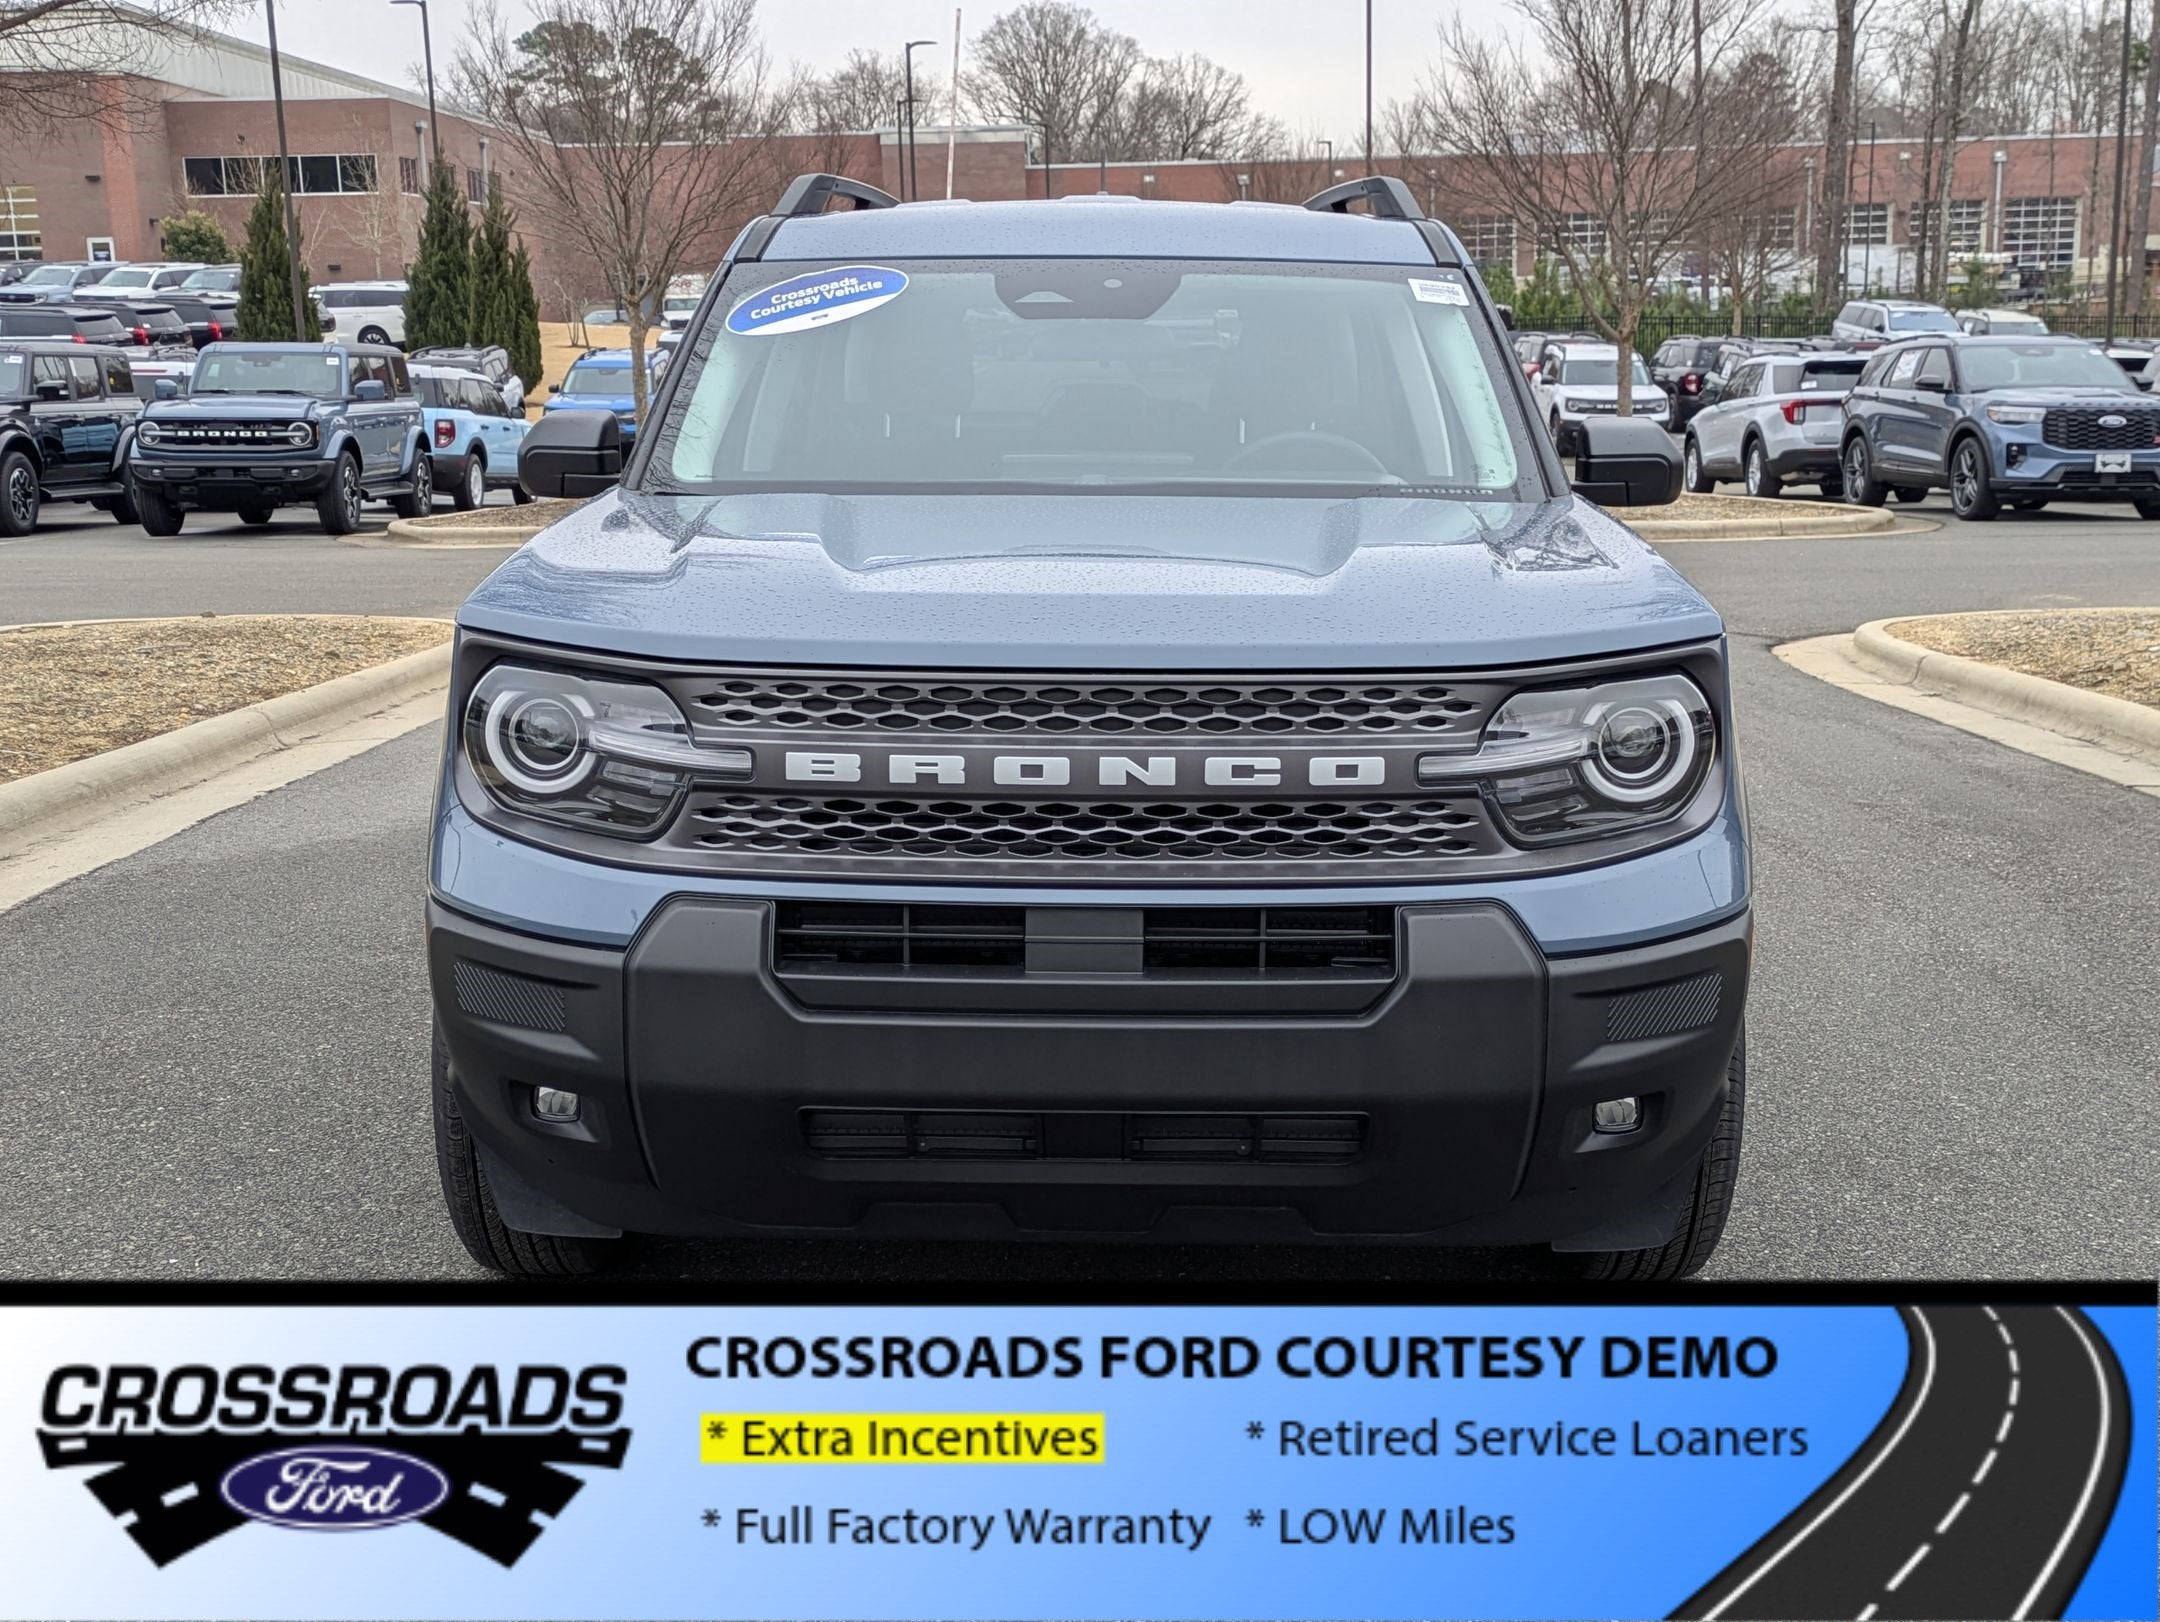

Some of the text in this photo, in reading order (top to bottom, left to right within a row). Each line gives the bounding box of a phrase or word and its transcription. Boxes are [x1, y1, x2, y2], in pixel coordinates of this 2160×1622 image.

[750, 280, 884, 320] Courtesy Vehicle
[770, 277, 859, 305] Crossroads
[785, 751, 1386, 786] BRONCO
